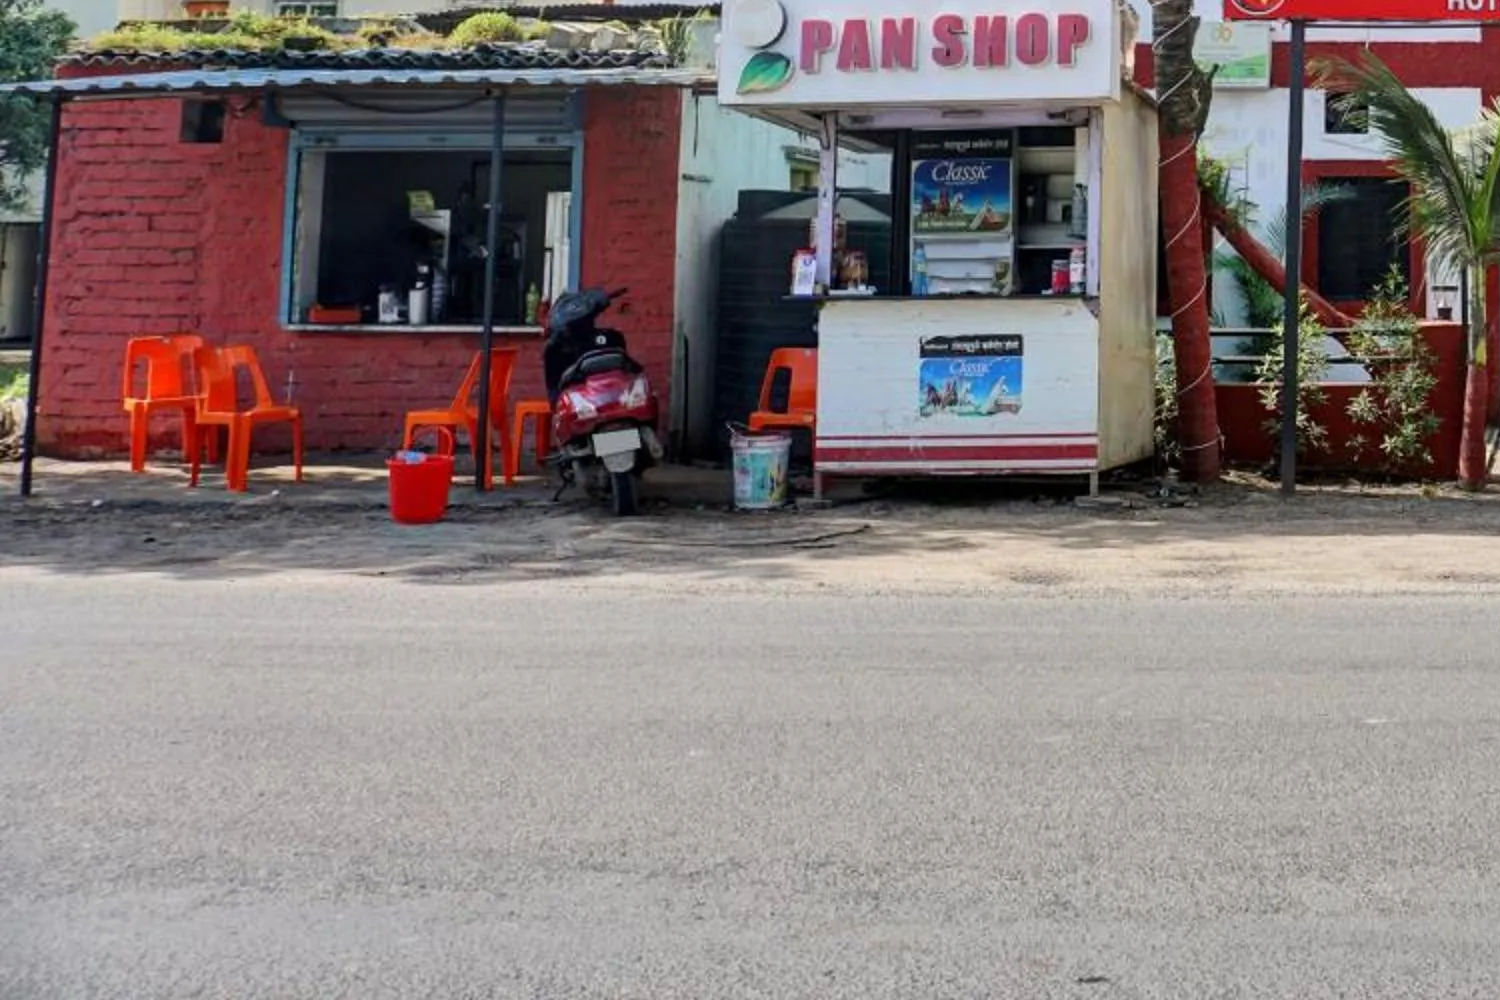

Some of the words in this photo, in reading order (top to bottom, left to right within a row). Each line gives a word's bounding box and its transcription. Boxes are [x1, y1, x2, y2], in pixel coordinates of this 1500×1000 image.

[800, 16, 916, 73] PAN
[931, 13, 1093, 69] SHOP
[932, 160, 993, 183] Classic
